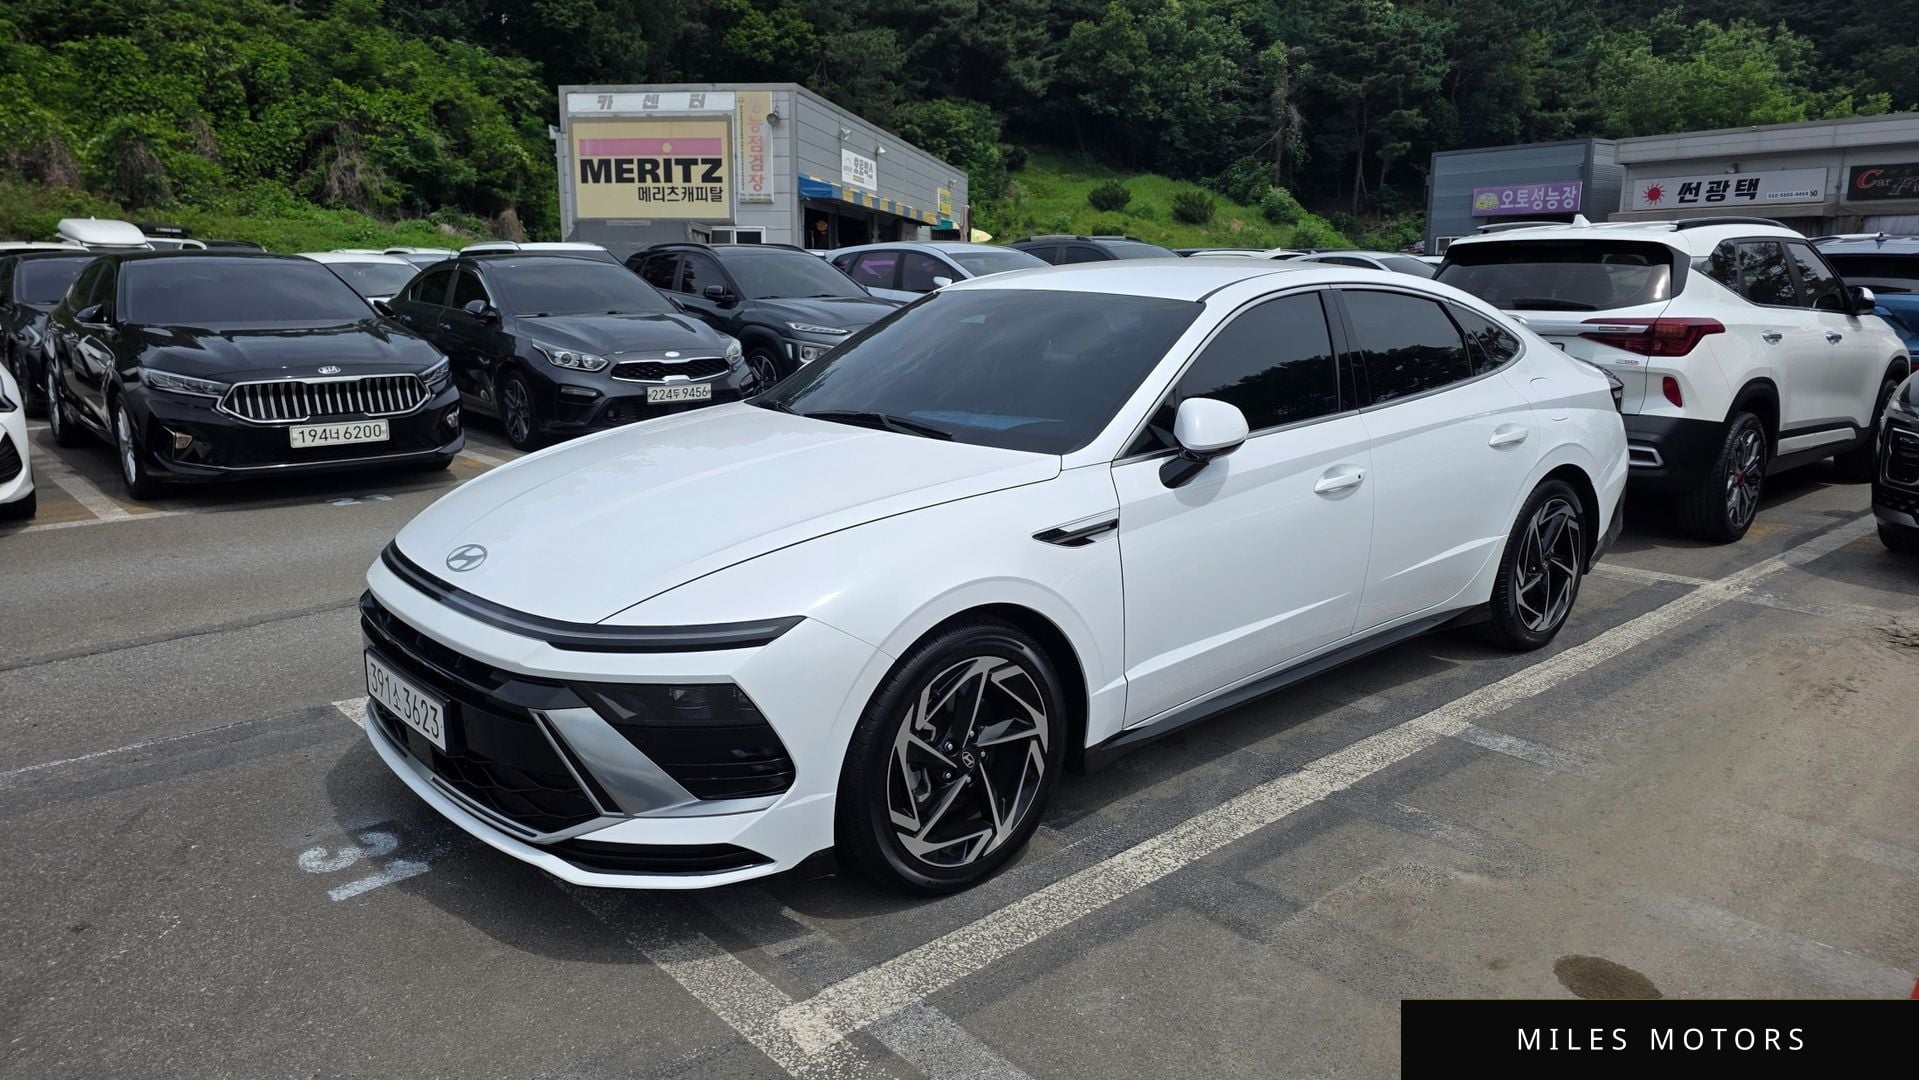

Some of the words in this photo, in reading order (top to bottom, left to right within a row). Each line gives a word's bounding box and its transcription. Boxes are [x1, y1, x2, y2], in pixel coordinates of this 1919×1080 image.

[580, 158, 723, 184] MERITZ
[1856, 168, 1892, 189] Car
[638, 186, 723, 202] 메리츠캐피탈
[1500, 185, 1578, 210] 오토성능장
[1677, 177, 1760, 204] 썬광택
[652, 388, 680, 401] 224두
[682, 386, 708, 398] 9456
[299, 428, 340, 443] 194너
[343, 424, 381, 440] 6200
[370, 662, 401, 711] 391소
[403, 687, 439, 739] 3623
